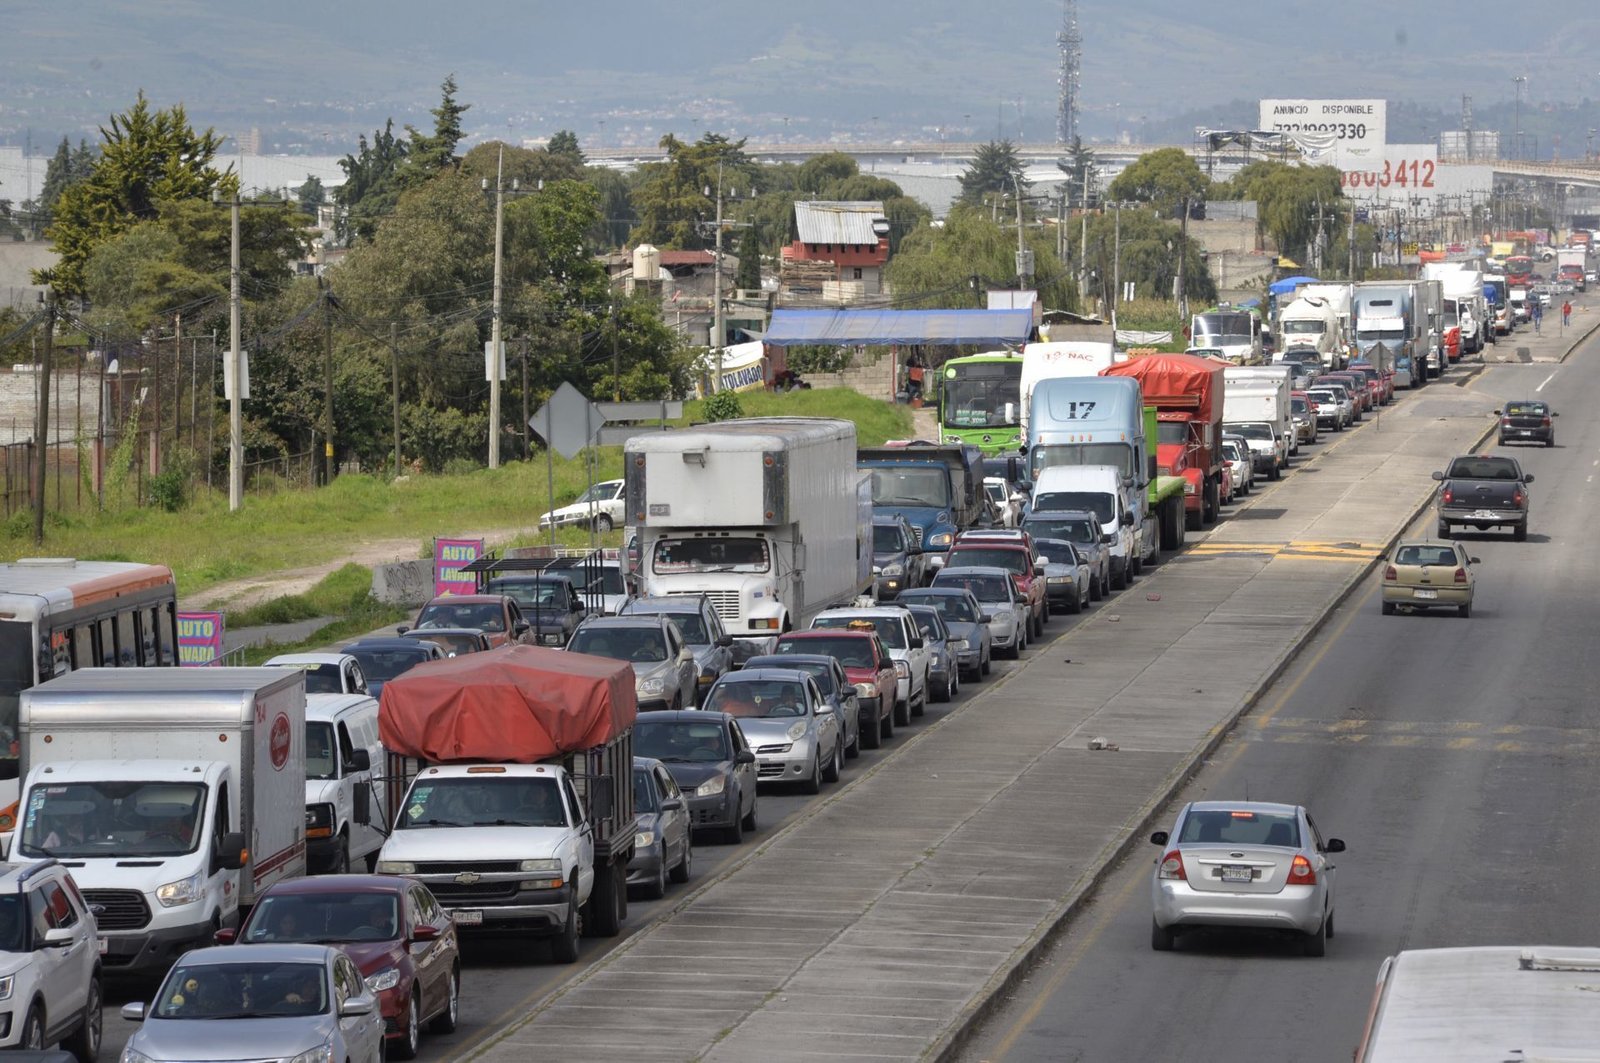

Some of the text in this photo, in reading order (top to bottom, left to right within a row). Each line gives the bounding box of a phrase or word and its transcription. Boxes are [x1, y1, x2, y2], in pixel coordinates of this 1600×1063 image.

[1273, 104, 1374, 115] ANUNCIO DISPONIBLE
[1067, 401, 1096, 420] 17
[442, 545, 476, 561] AUTO
